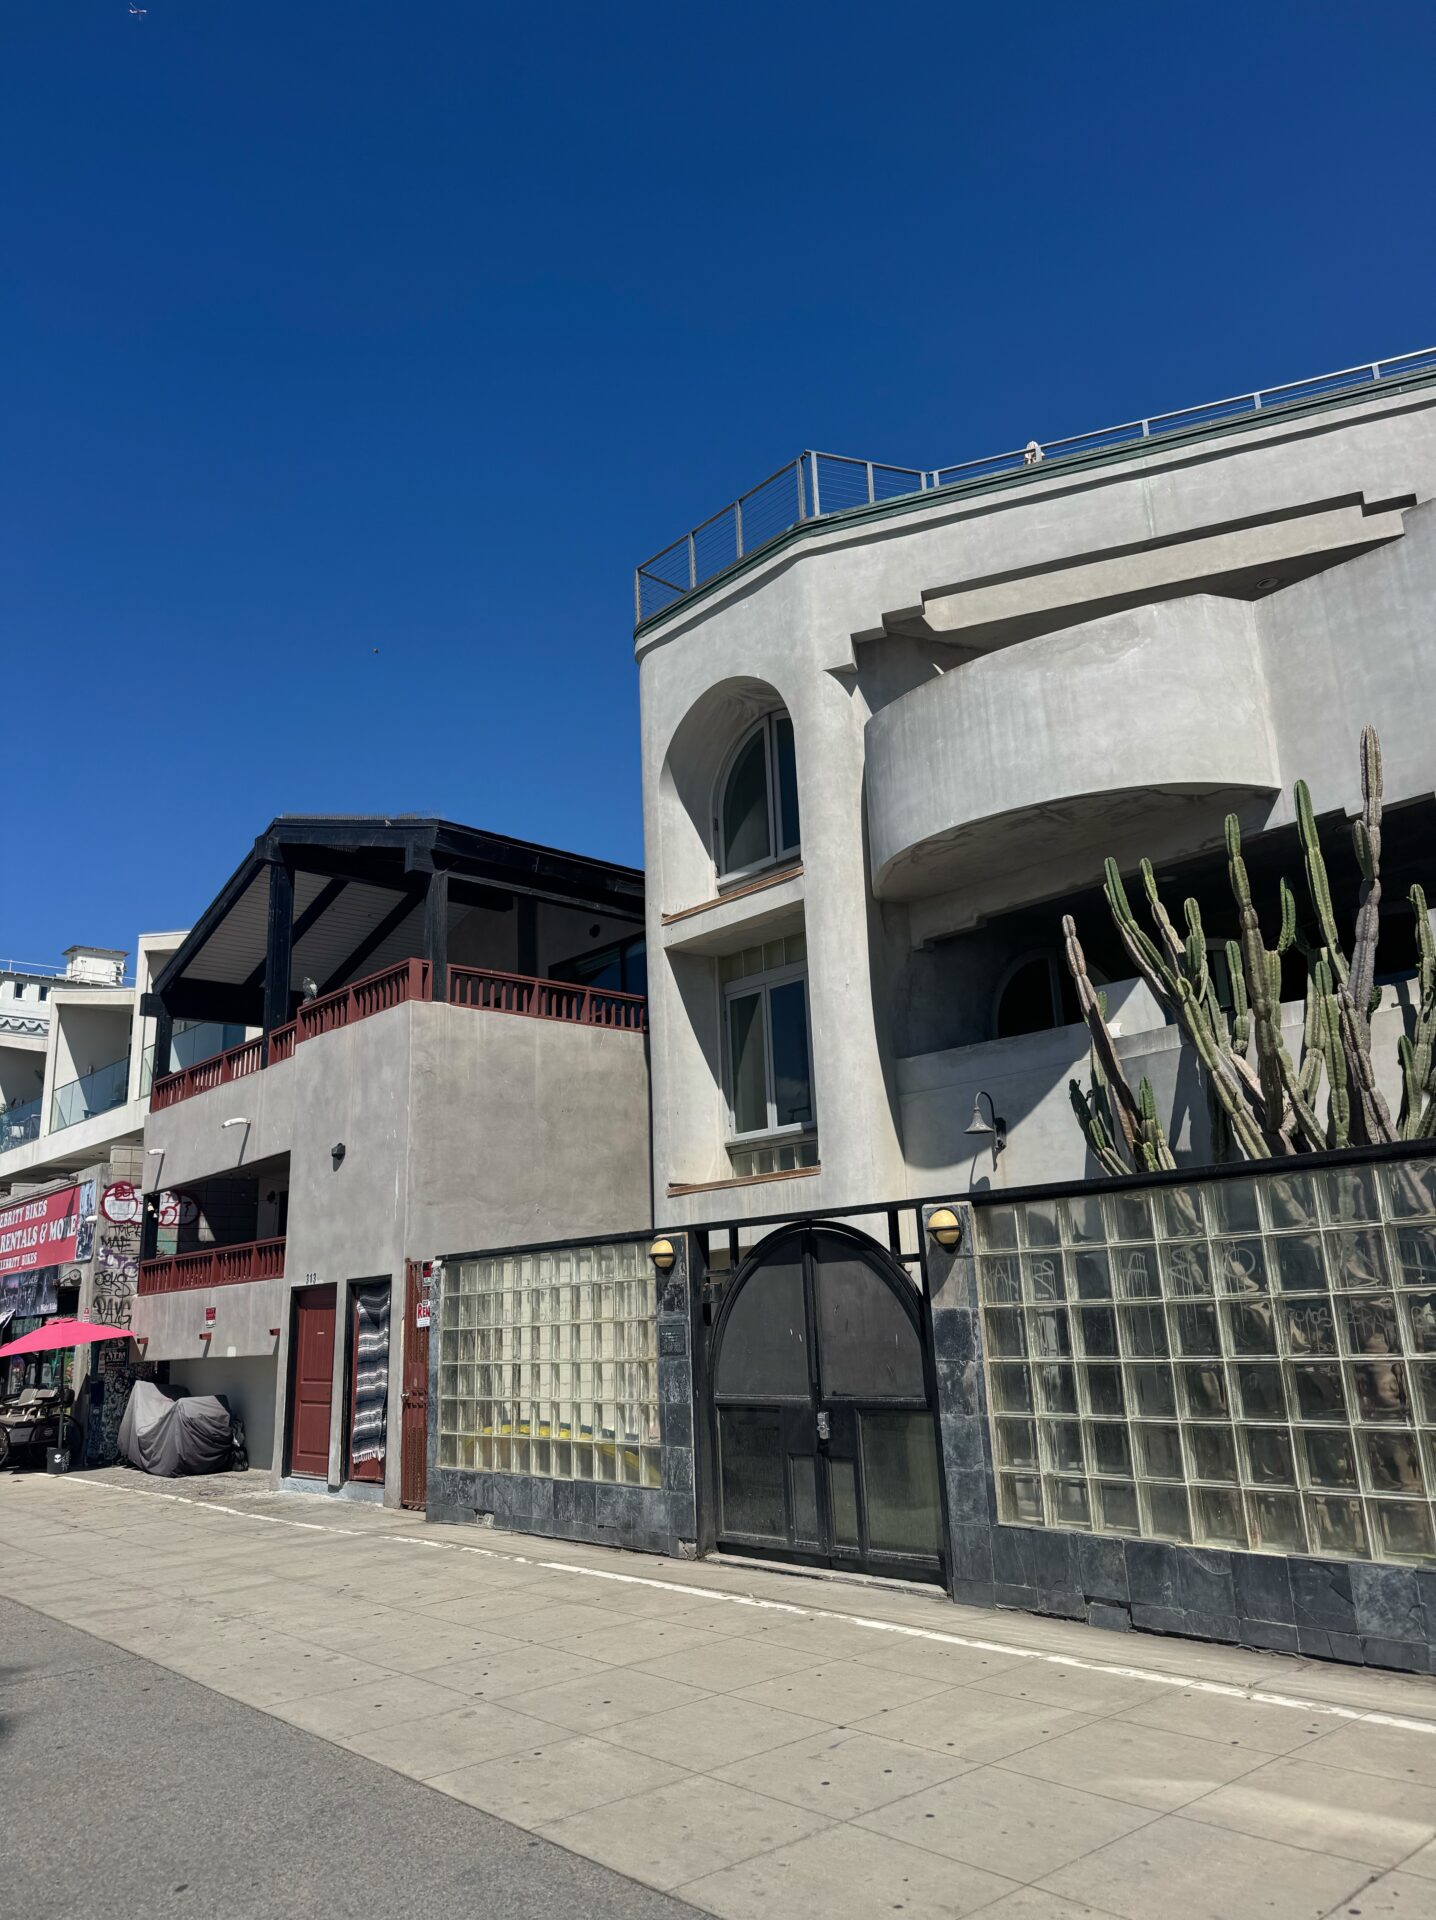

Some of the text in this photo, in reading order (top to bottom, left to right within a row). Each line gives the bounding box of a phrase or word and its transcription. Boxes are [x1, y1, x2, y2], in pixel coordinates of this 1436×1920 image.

[25, 1199, 48, 1221] BIKES
[0, 1214, 78, 1253] RENTALS & MORE
[306, 1272, 317, 1285] 313
[106, 1351, 126, 1361] ATM
